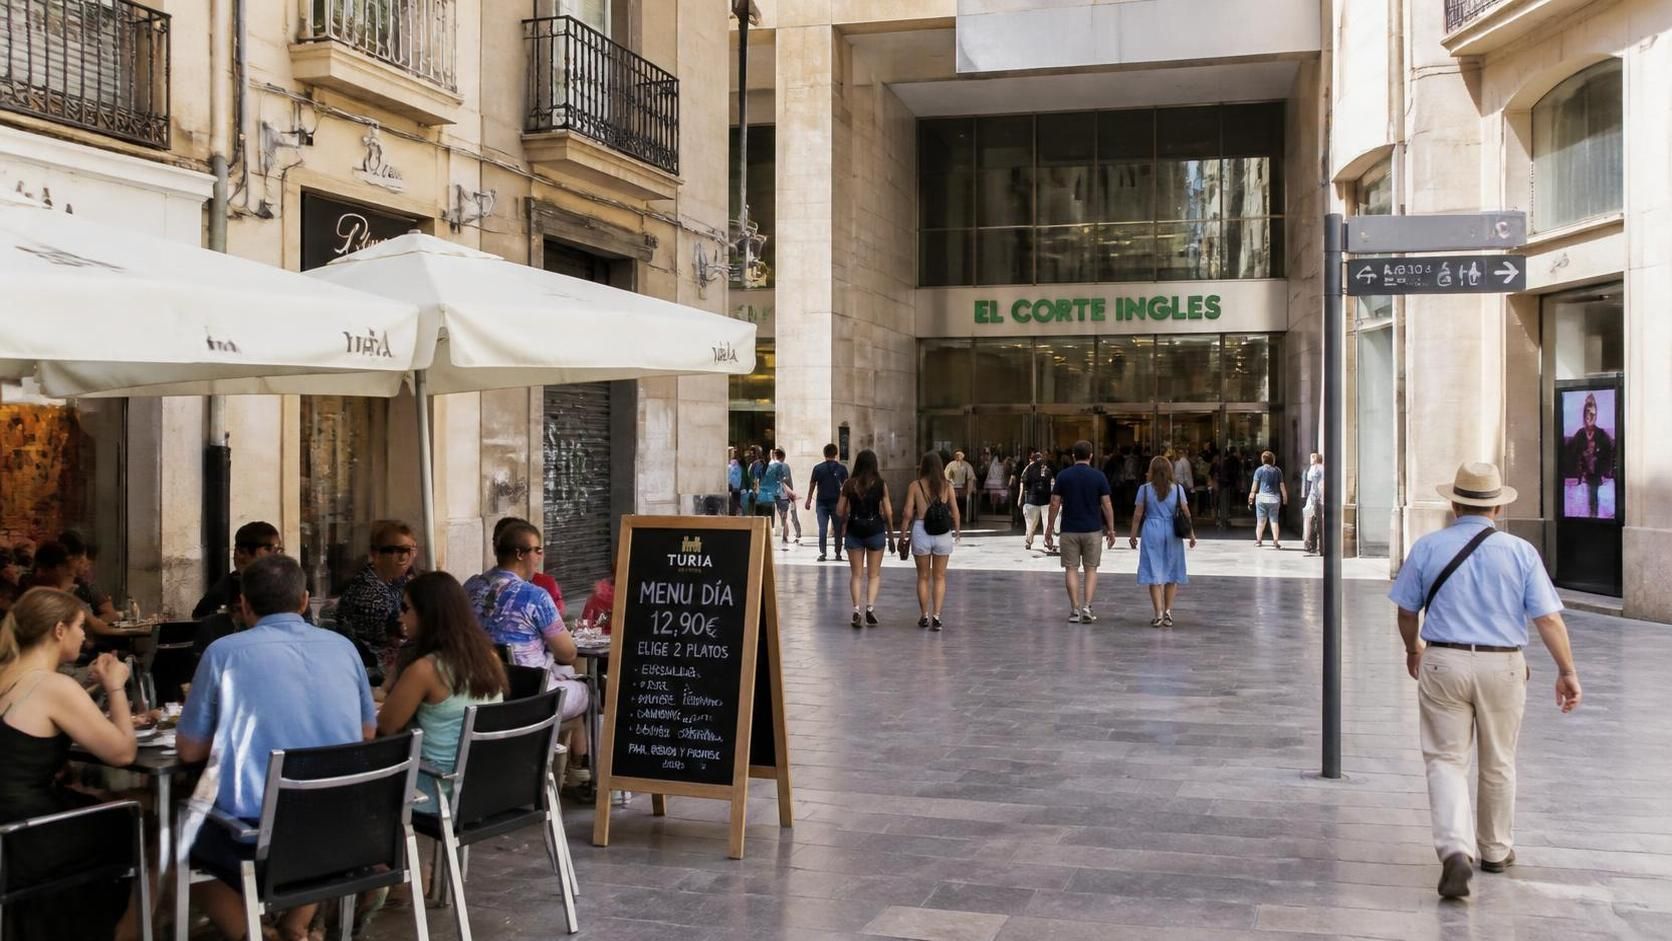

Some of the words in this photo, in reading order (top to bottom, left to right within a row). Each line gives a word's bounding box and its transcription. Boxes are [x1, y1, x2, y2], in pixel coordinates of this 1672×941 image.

[974, 300, 1003, 323] EL
[1011, 298, 1106, 323] CORTE
[1115, 295, 1222, 321] INGLES
[667, 553, 713, 568] TURIA
[639, 581, 693, 605] MENU
[701, 579, 734, 607] DÍA
[637, 641, 669, 656] ELIGE
[673, 642, 682, 657] 2
[686, 643, 729, 659] PLATOS
